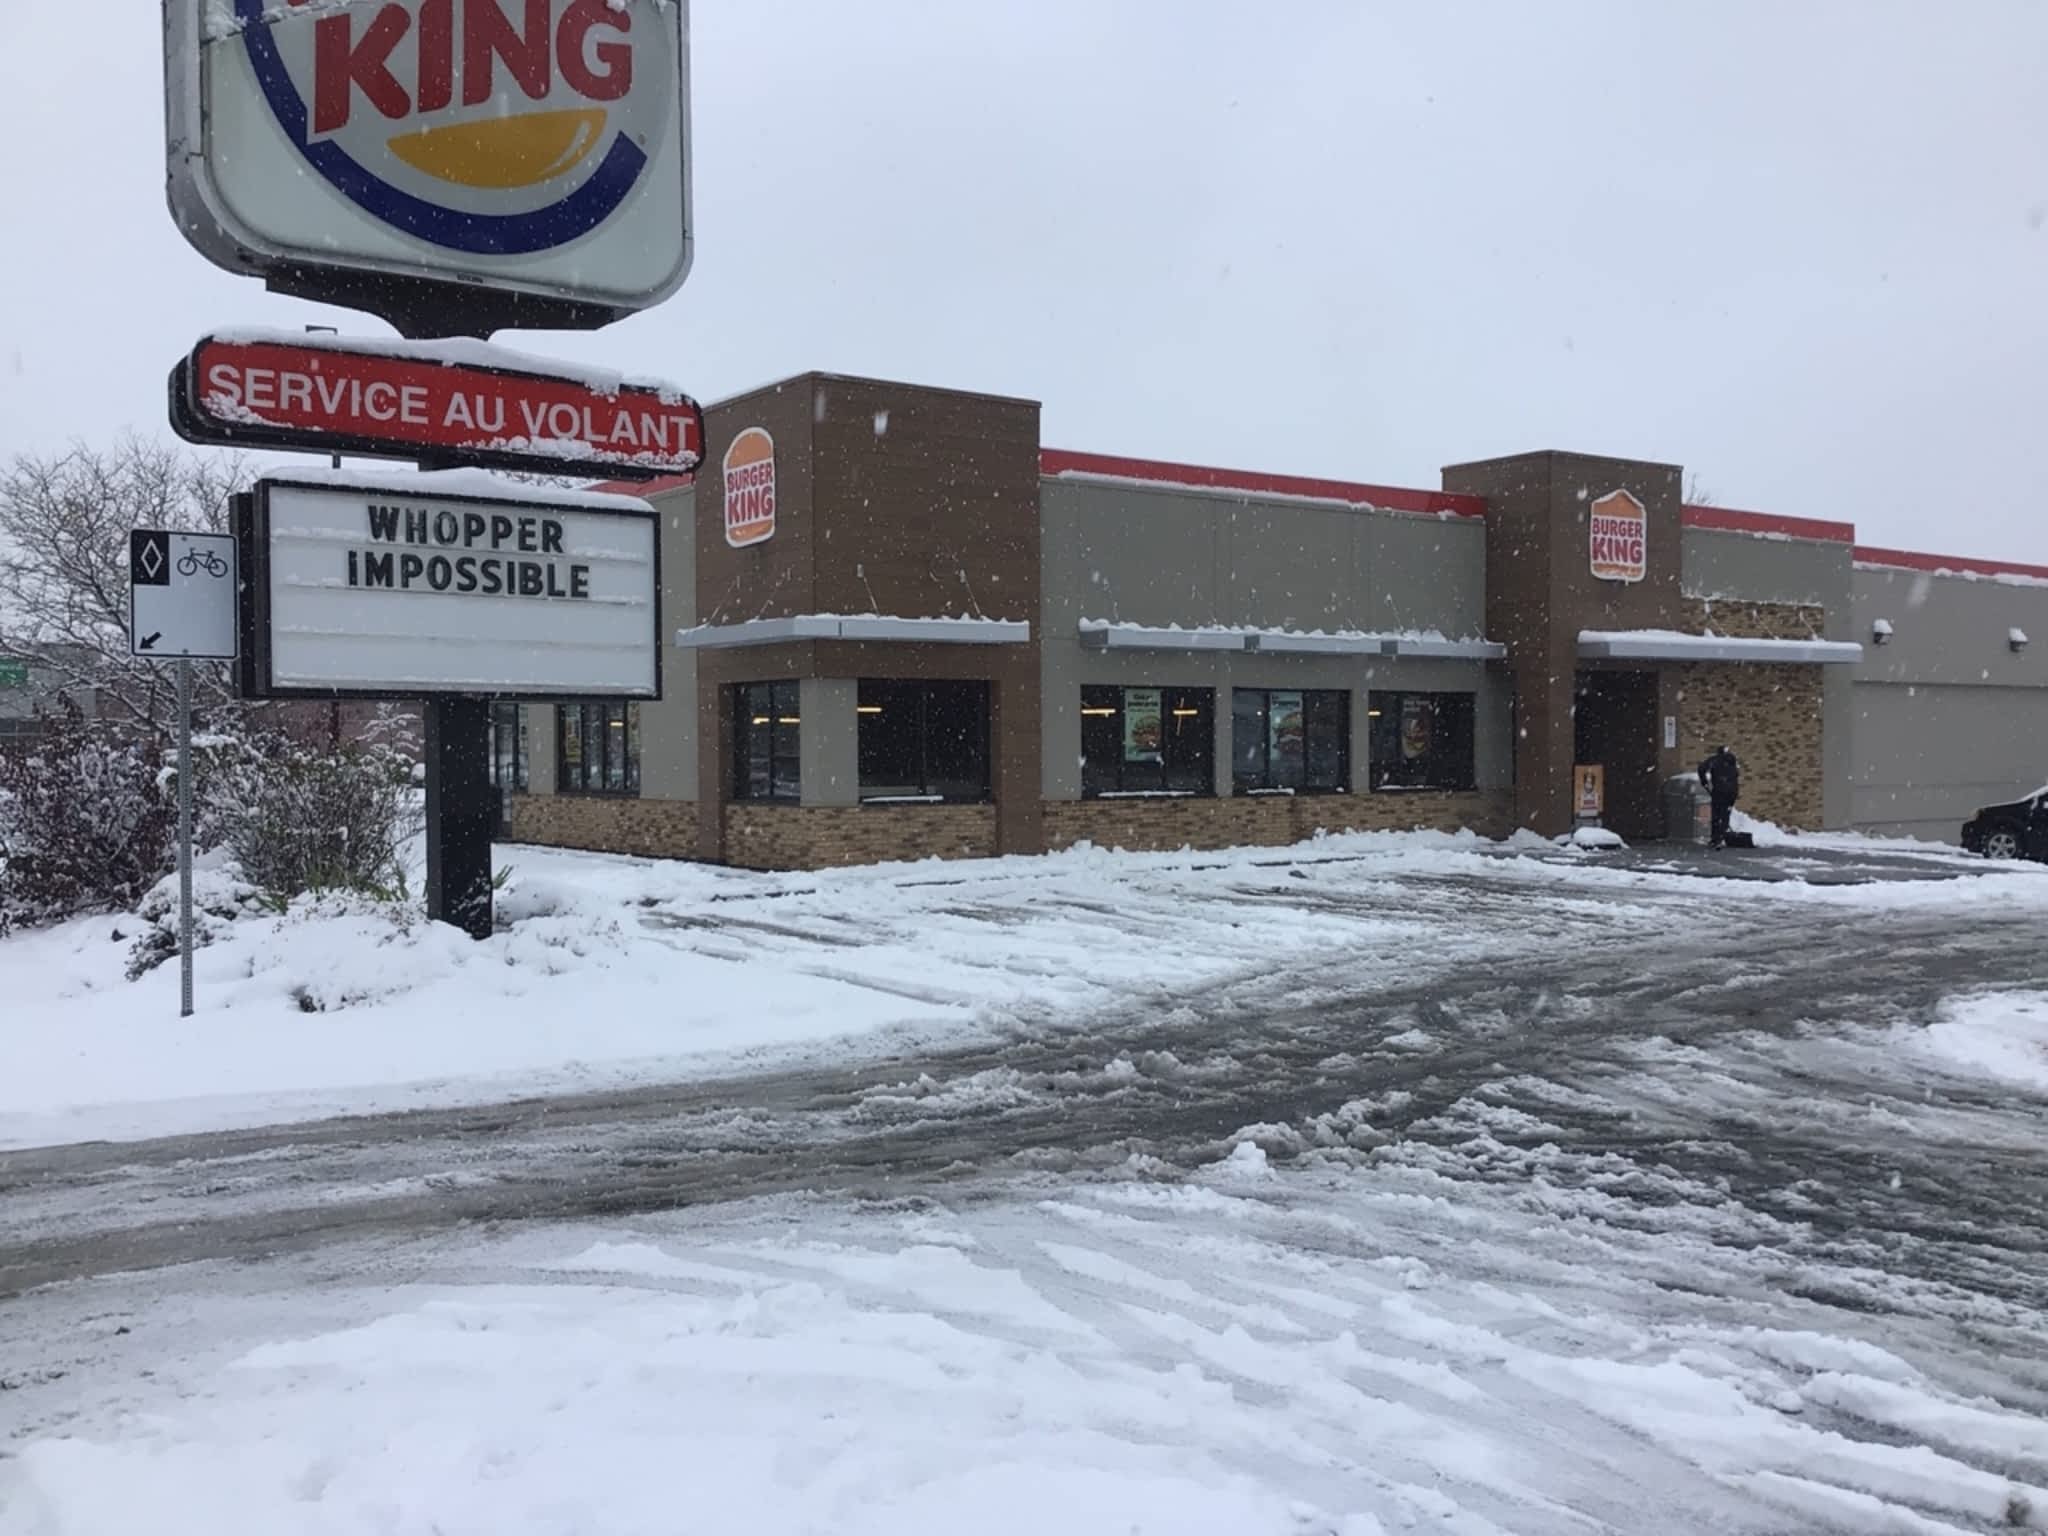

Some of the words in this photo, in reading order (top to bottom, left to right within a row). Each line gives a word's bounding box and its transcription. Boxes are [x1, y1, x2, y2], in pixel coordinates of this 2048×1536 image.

[314, 0, 632, 133] KING
[208, 363, 430, 425] SERVICE
[443, 392, 504, 432] AU
[519, 399, 696, 450] VOLANT
[727, 462, 773, 493] BURGER
[728, 486, 773, 525] KING
[368, 505, 564, 553] WHOPPER
[1592, 517, 1643, 538] BURGER
[1592, 536, 1643, 564] KING
[348, 550, 589, 598] IMPOSSIBLE
